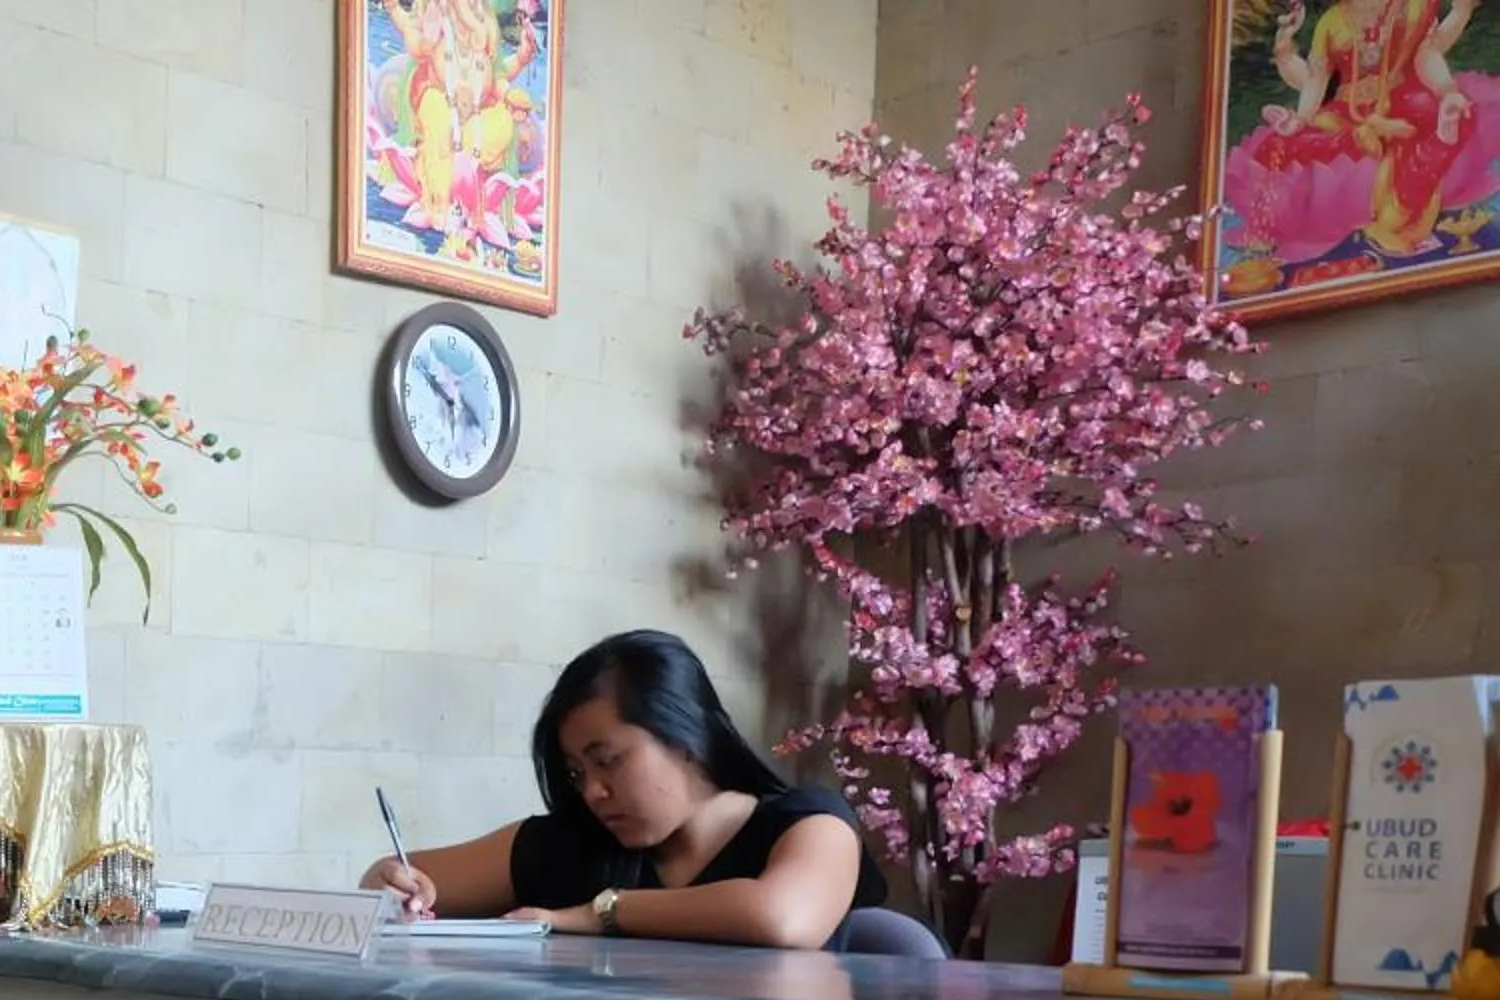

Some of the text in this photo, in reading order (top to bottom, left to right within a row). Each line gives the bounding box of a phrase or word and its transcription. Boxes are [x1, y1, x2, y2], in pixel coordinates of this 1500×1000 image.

[448, 336, 457, 351] 12
[1366, 818, 1437, 838] UBUD
[1365, 841, 1442, 860] CARE
[1364, 863, 1440, 880] CLINIC
[202, 903, 368, 947] RECEPTION
